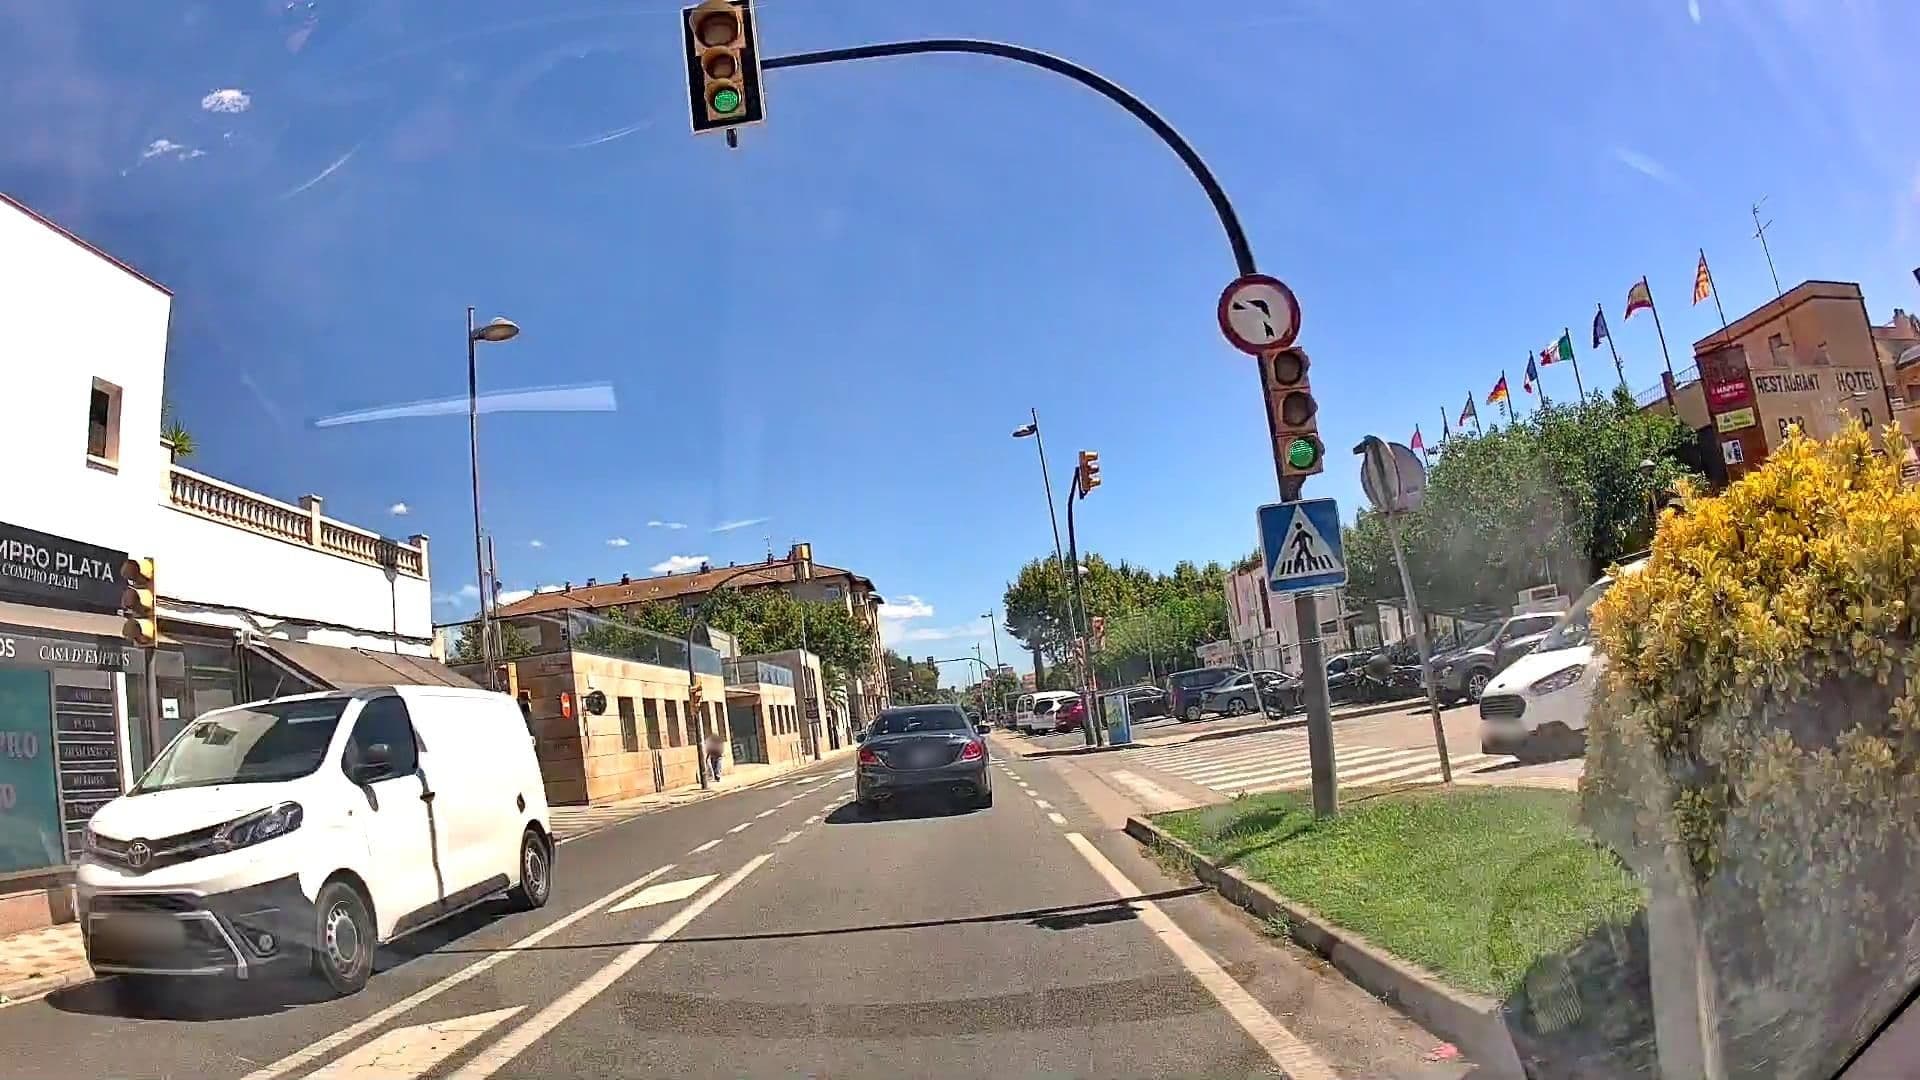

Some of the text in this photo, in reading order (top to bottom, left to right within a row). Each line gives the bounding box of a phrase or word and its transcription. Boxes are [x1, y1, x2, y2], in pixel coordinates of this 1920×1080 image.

[1755, 371, 1880, 394] RESTAURANT HOTEL
[56, 551, 114, 583] PLATA
